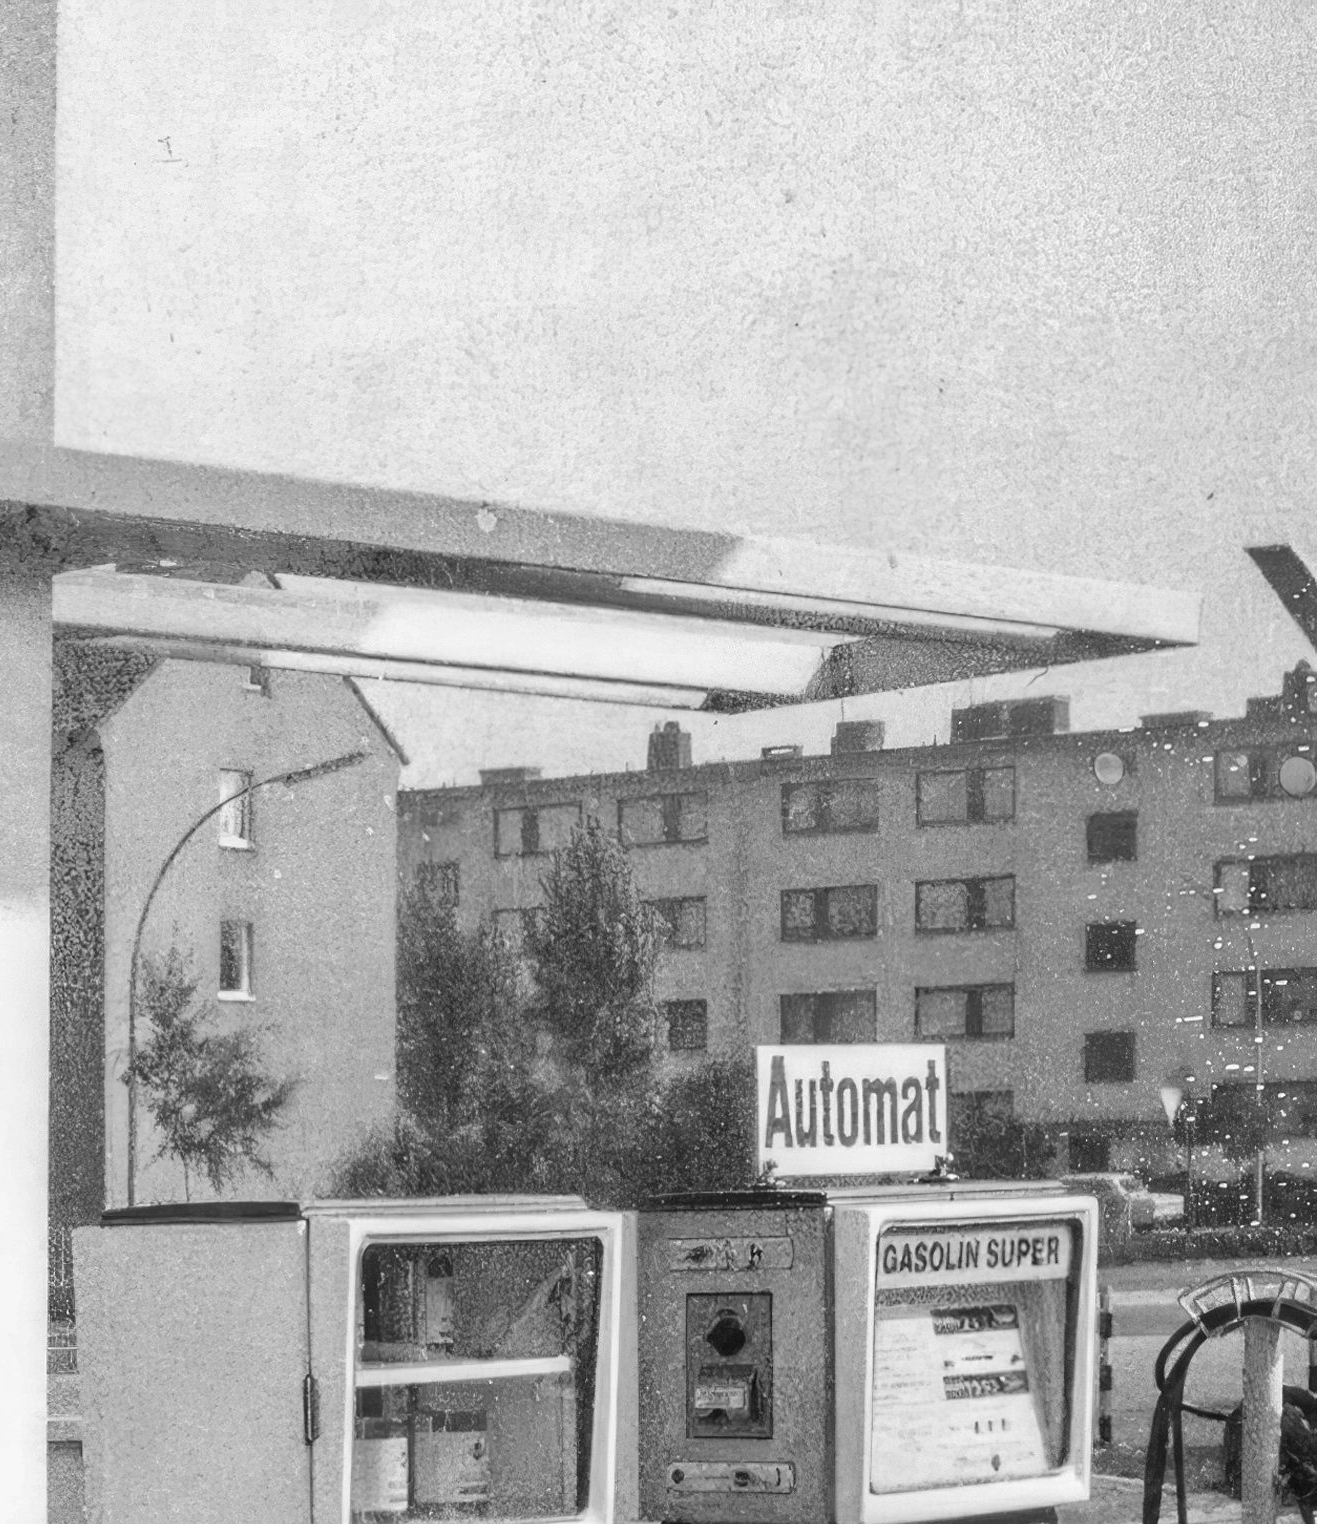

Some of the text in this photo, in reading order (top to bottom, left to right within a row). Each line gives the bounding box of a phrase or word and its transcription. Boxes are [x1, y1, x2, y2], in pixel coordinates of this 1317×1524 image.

[765, 1055, 941, 1148] Automat
[882, 1235, 1060, 1274] GASOLIN SUPER
